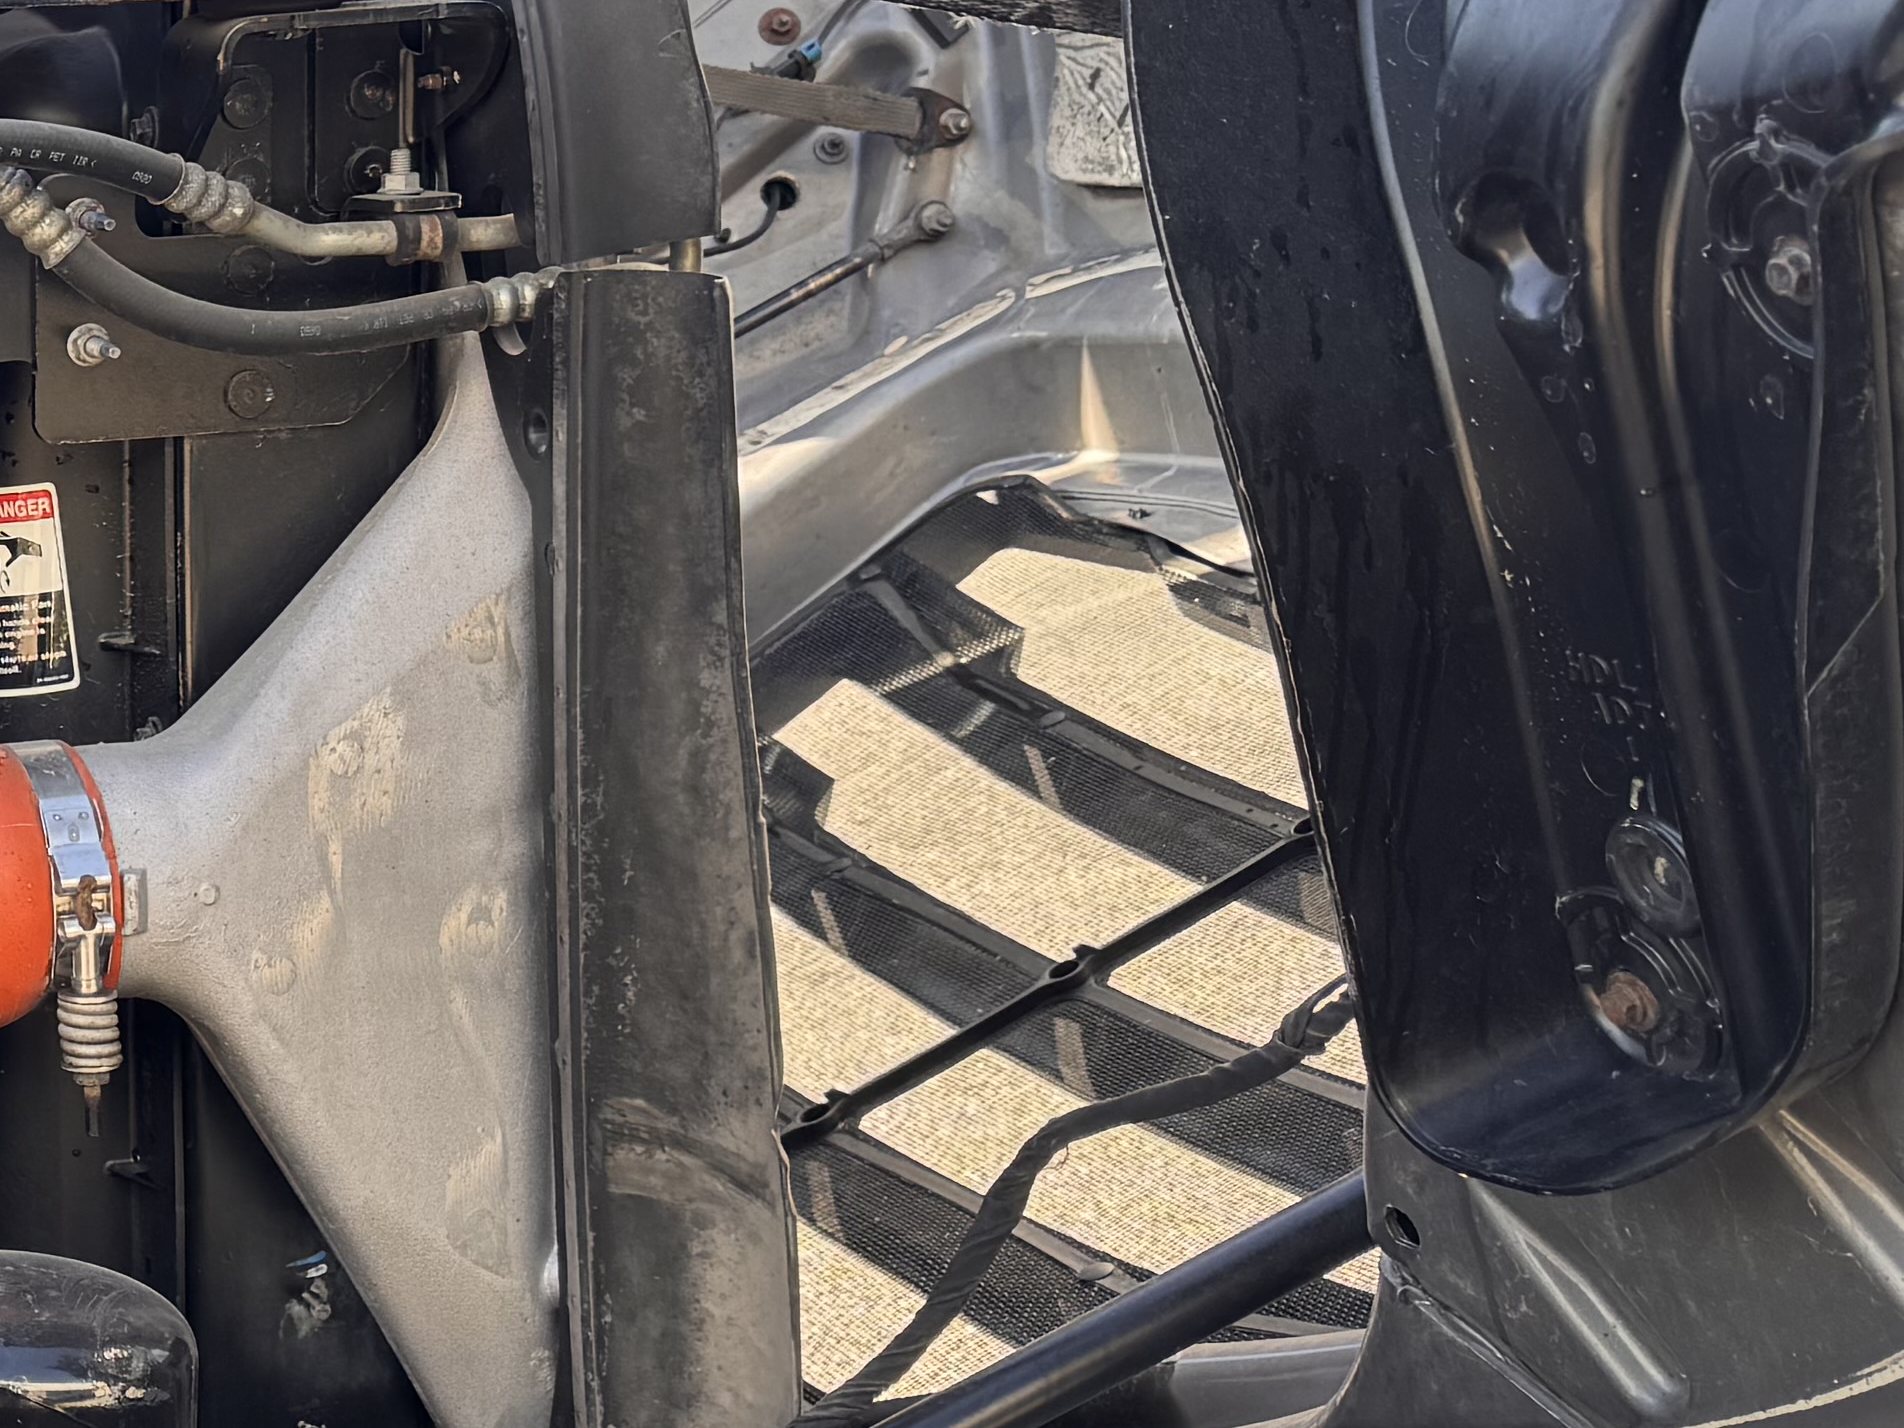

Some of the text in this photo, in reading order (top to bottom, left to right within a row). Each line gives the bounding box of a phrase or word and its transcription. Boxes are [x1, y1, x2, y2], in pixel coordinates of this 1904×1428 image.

[31, 599, 53, 612] Fan
[2, 616, 30, 629] hands
[4, 628, 35, 641] engine
